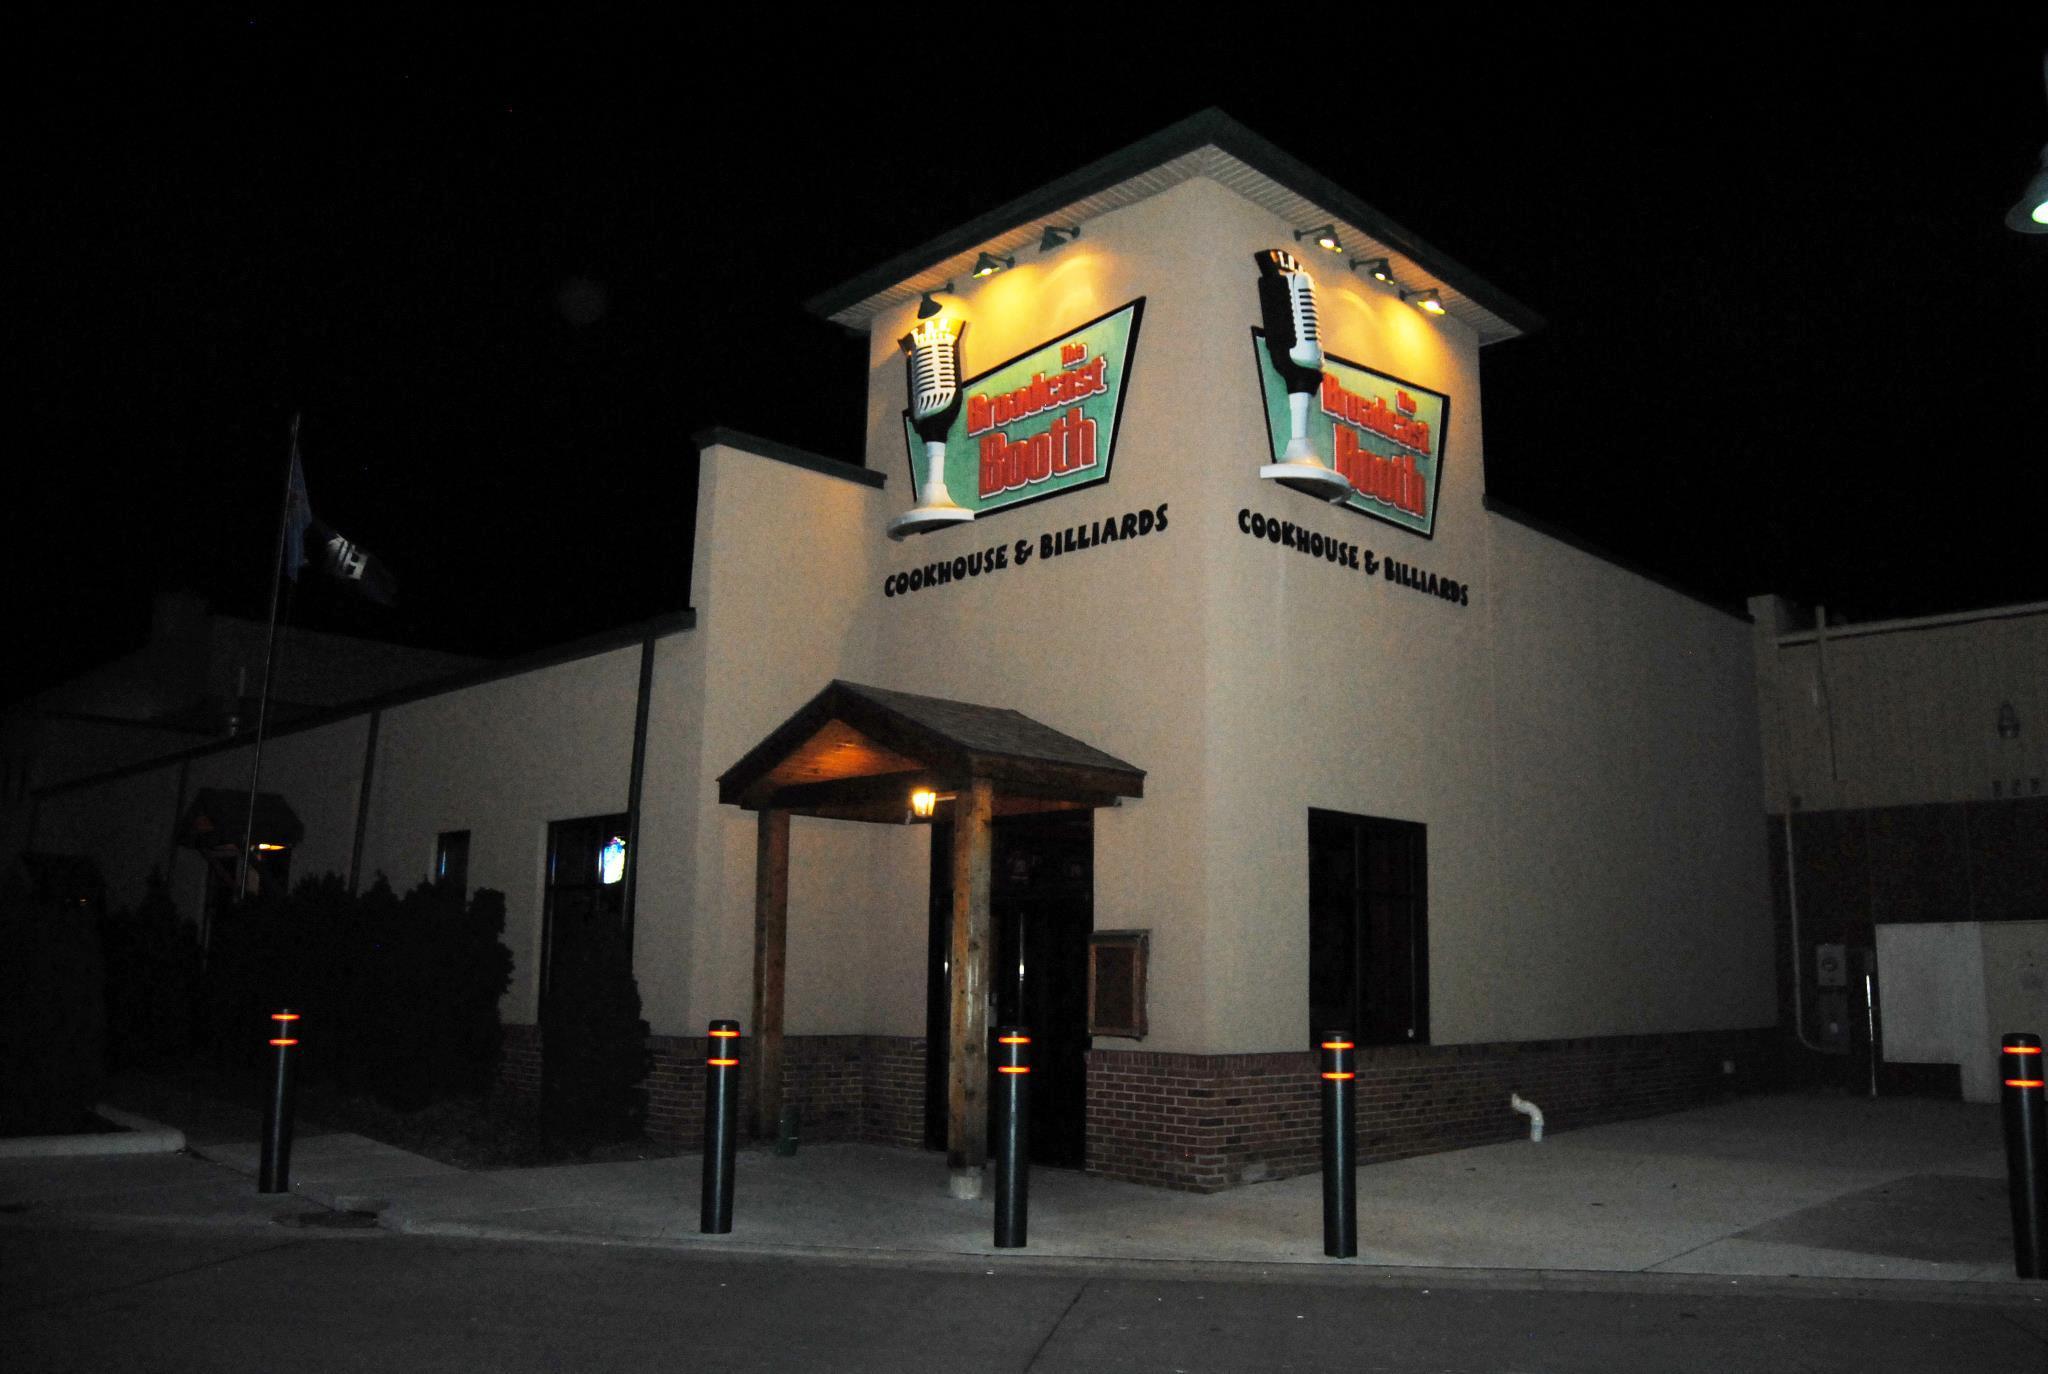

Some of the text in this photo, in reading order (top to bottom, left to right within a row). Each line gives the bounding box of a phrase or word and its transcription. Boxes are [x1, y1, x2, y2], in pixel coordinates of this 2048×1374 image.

[967, 355, 1108, 437] Broadcast
[978, 407, 1098, 499] Booth
[884, 503, 1169, 598] COOKHOUSE & BILLIARDS
[1238, 508, 1469, 607] COOKHOUSE & BILLIARDS
